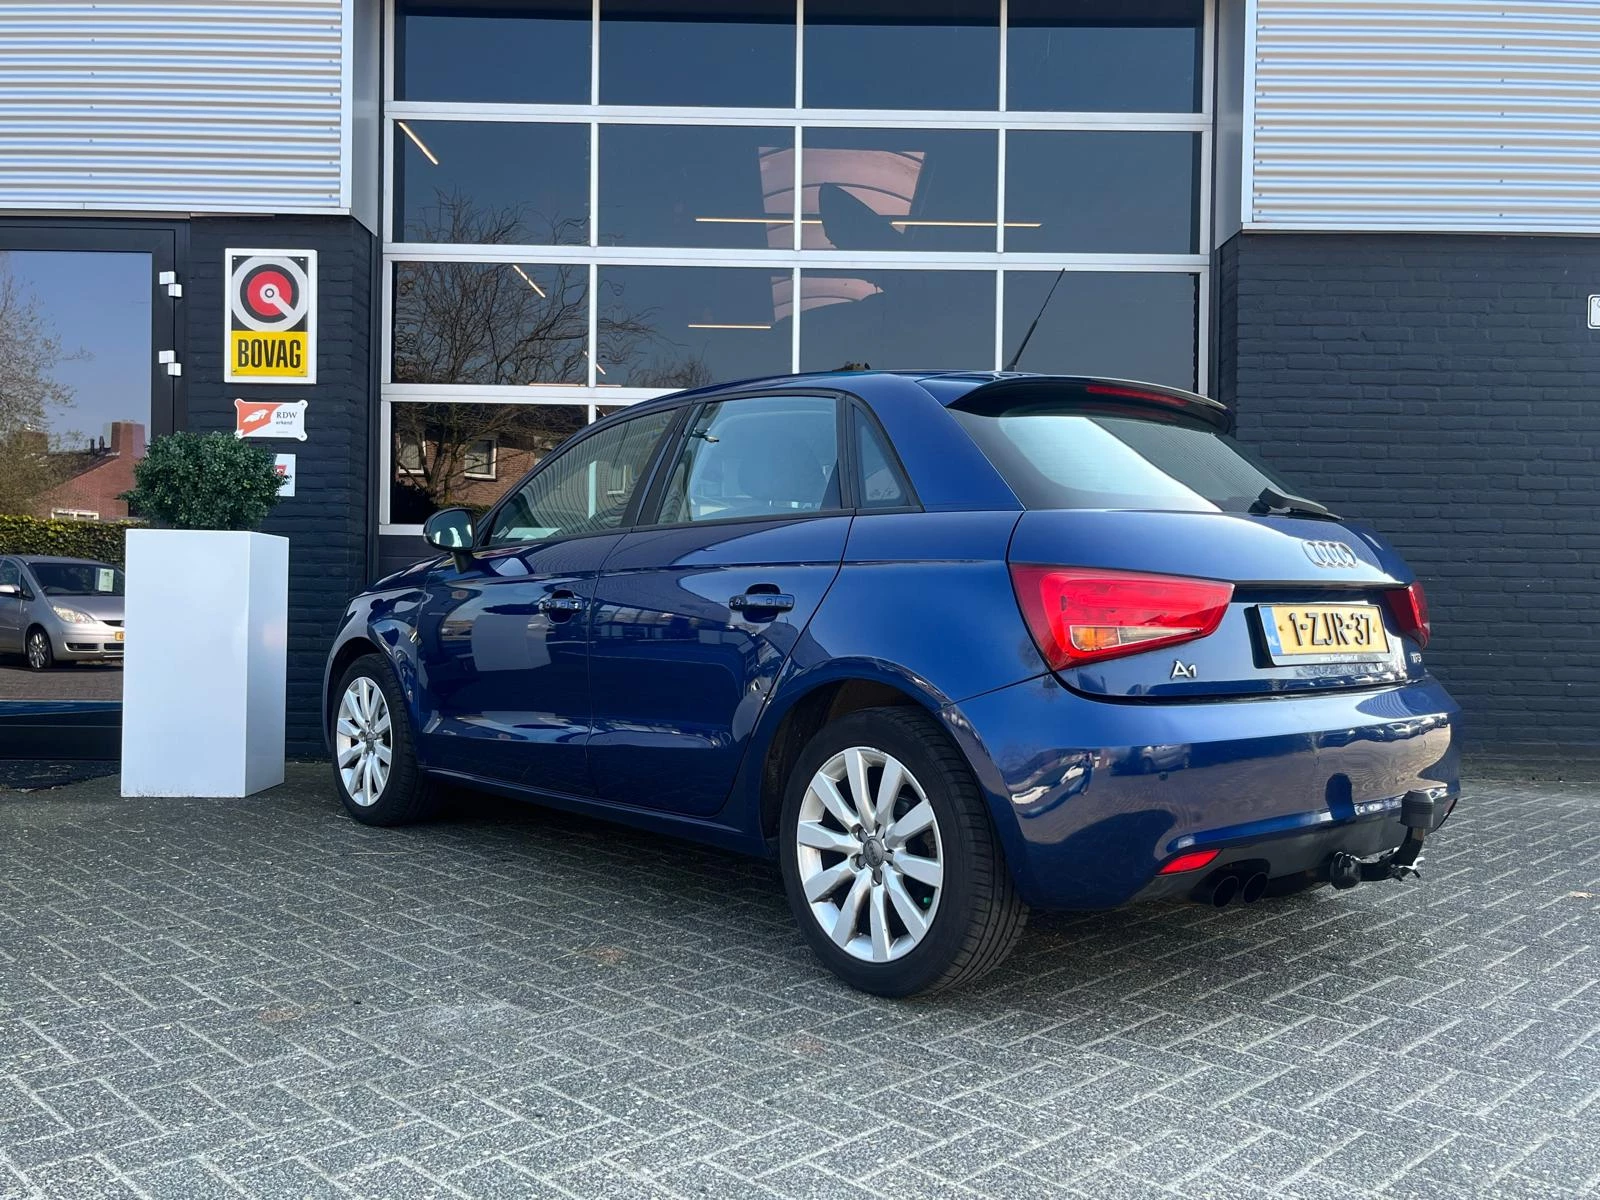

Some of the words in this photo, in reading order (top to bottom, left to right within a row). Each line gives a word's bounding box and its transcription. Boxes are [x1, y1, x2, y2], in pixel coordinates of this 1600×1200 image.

[237, 338, 302, 369] BOVAG
[276, 411, 298, 419] RDW
[1289, 612, 1372, 646] 1-ZJR-37
[1170, 659, 1197, 679] A1
